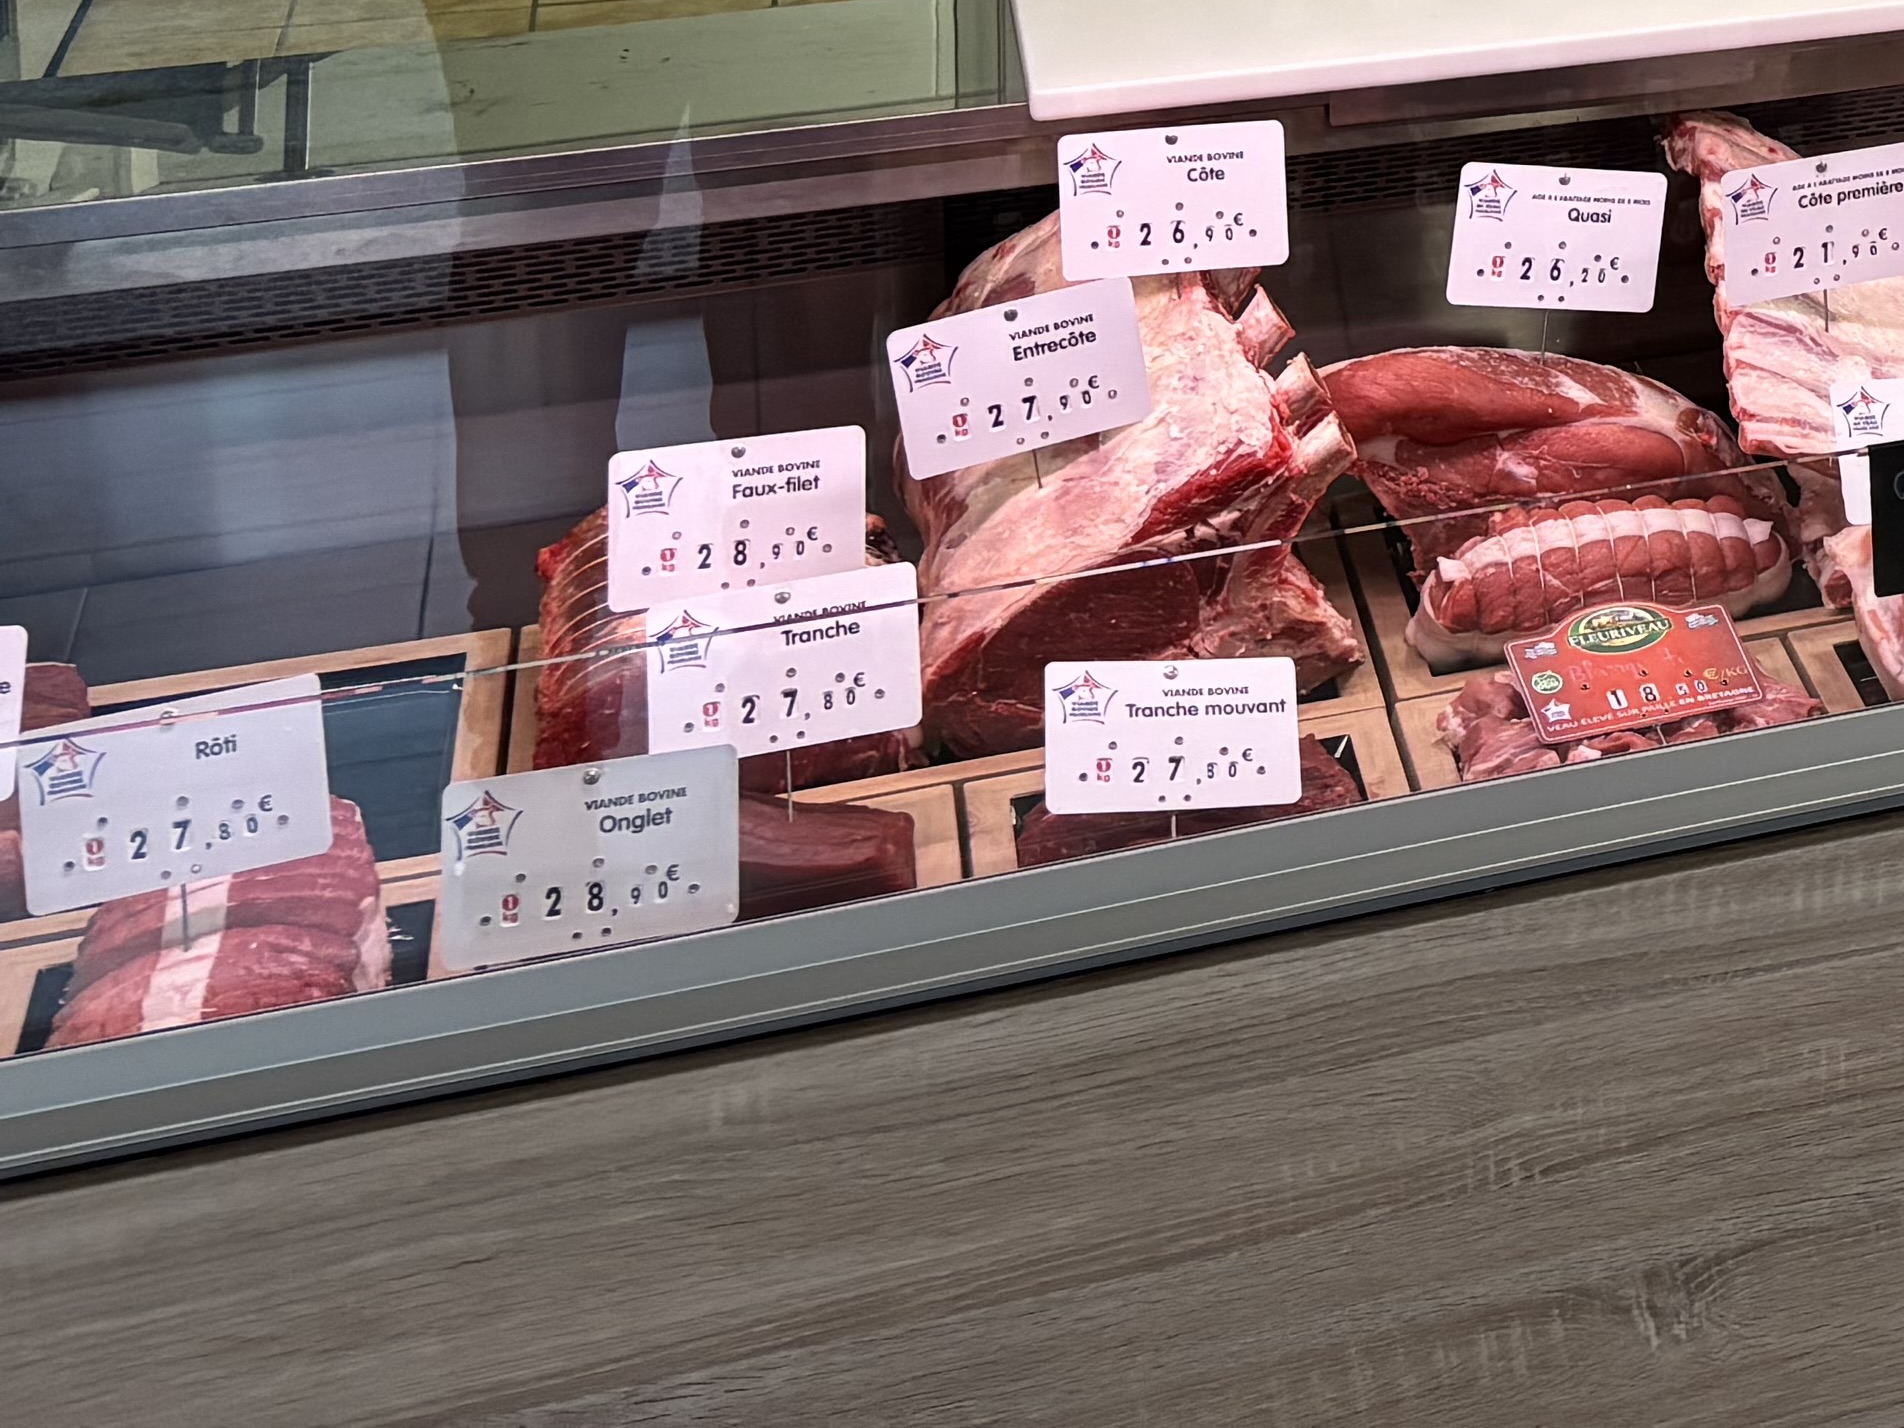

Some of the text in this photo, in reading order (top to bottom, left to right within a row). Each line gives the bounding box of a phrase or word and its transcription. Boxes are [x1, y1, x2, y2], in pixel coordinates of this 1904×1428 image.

[1166, 151, 1244, 164] VIANDE BOVINE
[1187, 166, 1225, 182] Côte
[1798, 181, 1904, 208] Côte première
[1568, 208, 1612, 223] Quasi
[1012, 329, 1097, 362] Entrecôte
[732, 460, 820, 478] VIANDE BOVINE
[732, 475, 820, 499] Faux-filet
[781, 620, 860, 646] Tranche
[1568, 617, 1670, 648] FLEURIVEAU
[1126, 699, 1286, 718] Tranche mouvant
[195, 734, 237, 760] Rôti
[600, 807, 673, 834] Onglet
